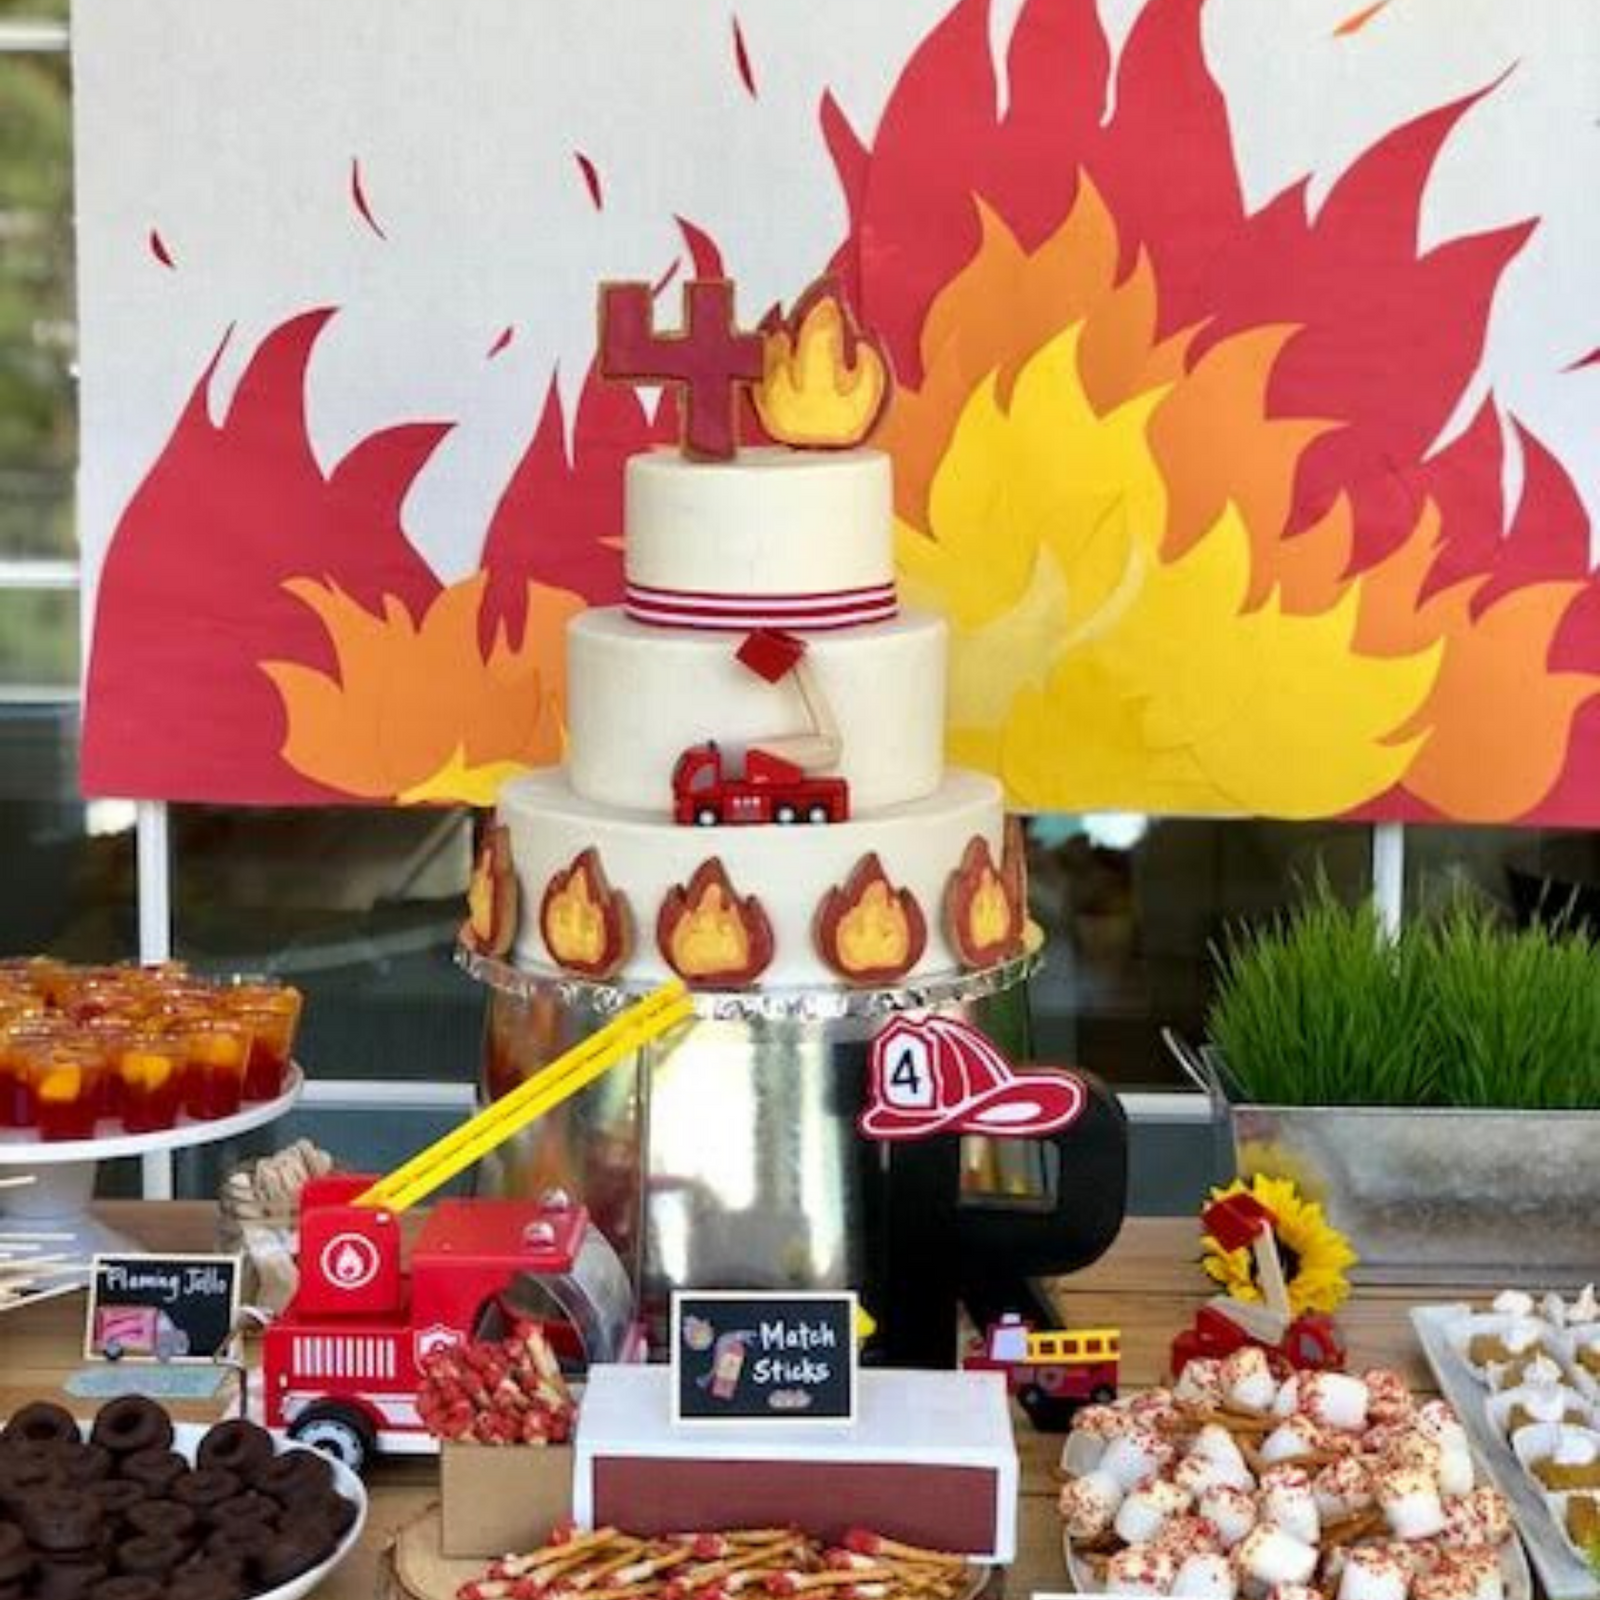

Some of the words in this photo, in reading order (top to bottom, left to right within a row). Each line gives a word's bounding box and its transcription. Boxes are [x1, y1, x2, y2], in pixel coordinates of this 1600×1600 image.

[597, 279, 766, 463] 4
[890, 1048, 919, 1095] 4
[759, 1320, 836, 1351] Match
[752, 1357, 831, 1385] Sticks
